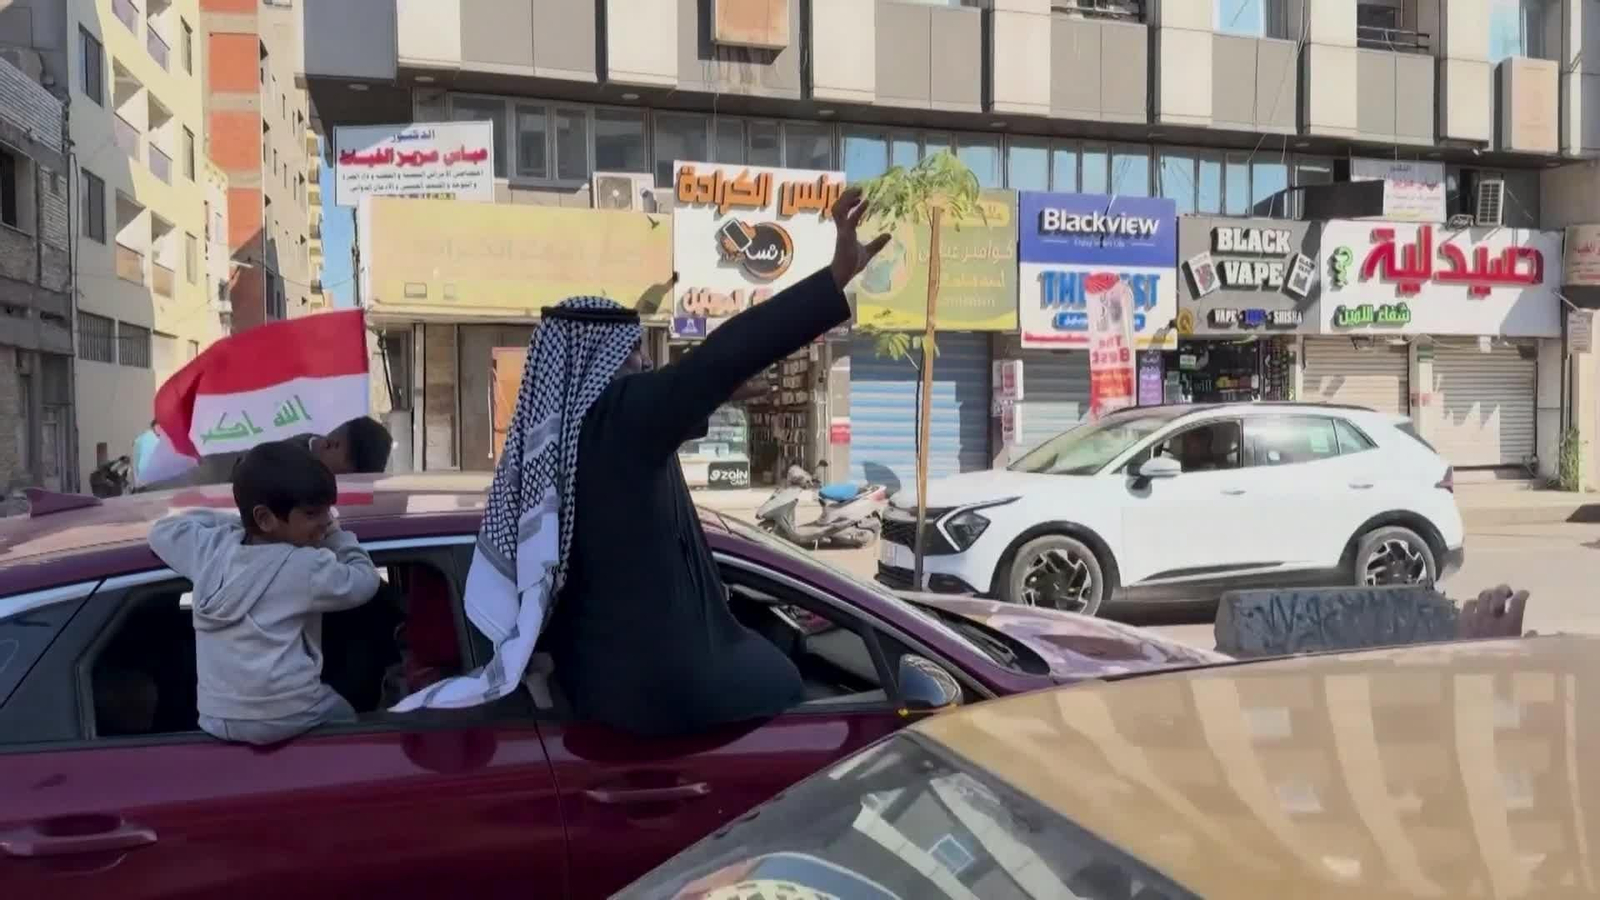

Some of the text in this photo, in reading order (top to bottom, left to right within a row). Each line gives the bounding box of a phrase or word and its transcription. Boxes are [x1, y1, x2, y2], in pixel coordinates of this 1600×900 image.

[678, 165, 773, 214] الكرادة
[1043, 208, 1160, 235] Blackview
[1217, 227, 1292, 253] BLACK
[1359, 224, 1544, 295] صيدلية
[1223, 260, 1284, 287] VAPE
[1214, 308, 1238, 324] VAPE
[1273, 310, 1303, 325] SHISHA
[273, 395, 312, 428] الله
